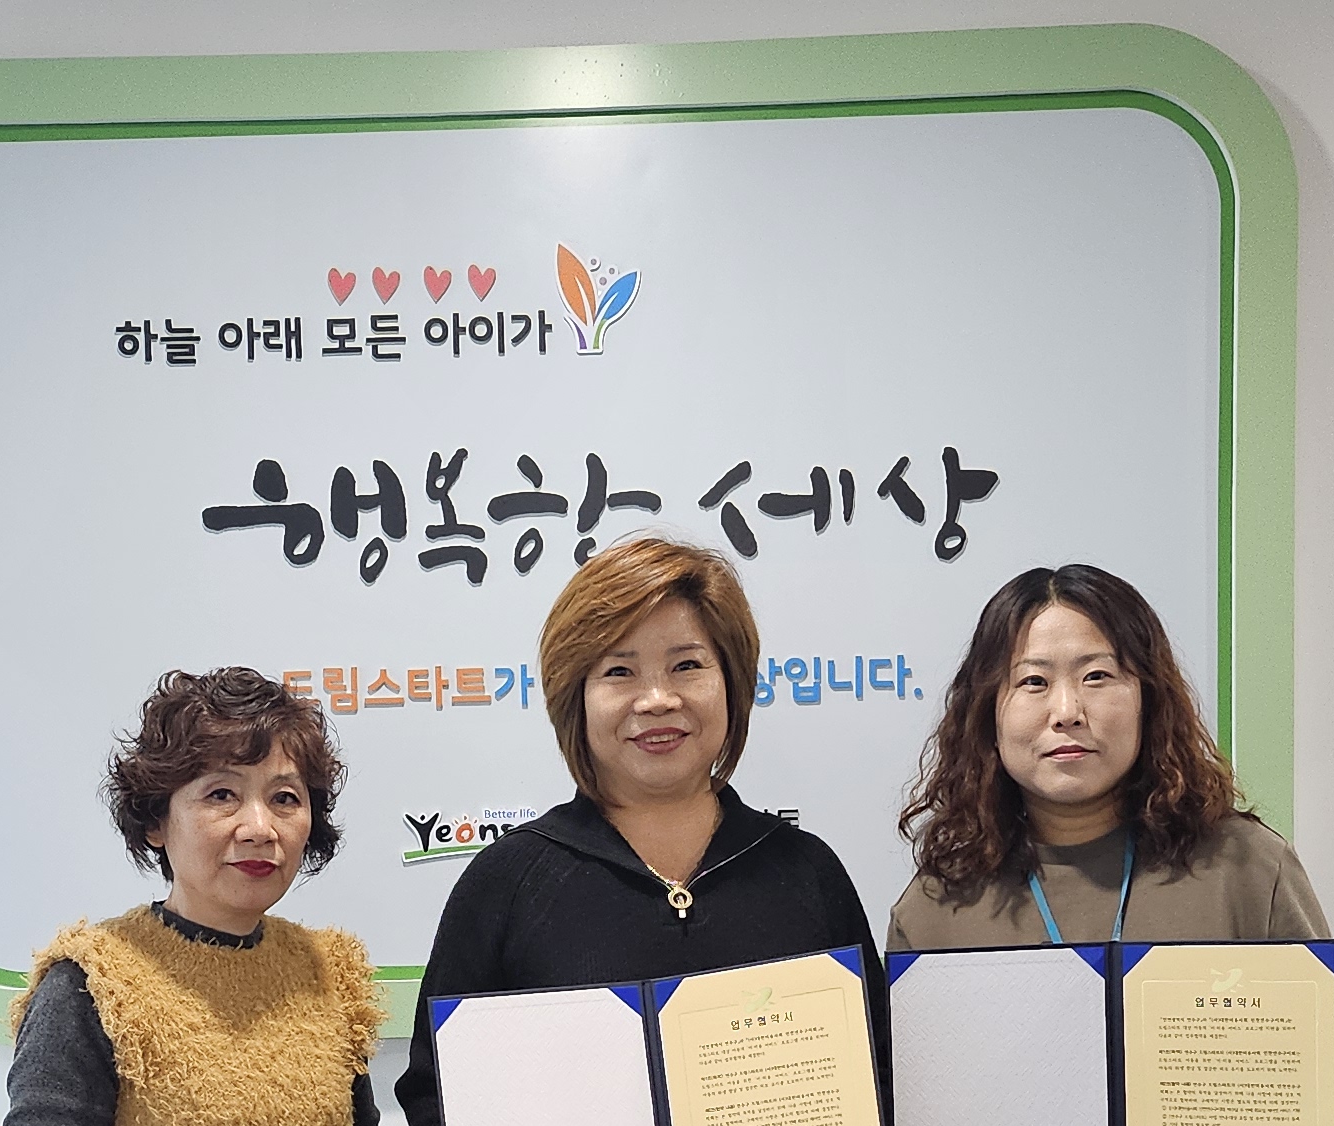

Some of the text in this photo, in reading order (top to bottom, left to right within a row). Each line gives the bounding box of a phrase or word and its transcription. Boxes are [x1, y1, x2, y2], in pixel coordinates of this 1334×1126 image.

[115, 308, 553, 364] 하늘 아래 모든 아이가
[698, 447, 1000, 562] 세상
[755, 655, 923, 706] 상입니다.
[484, 808, 537, 819] Better life
[1194, 996, 1262, 1009] 업무협약서
